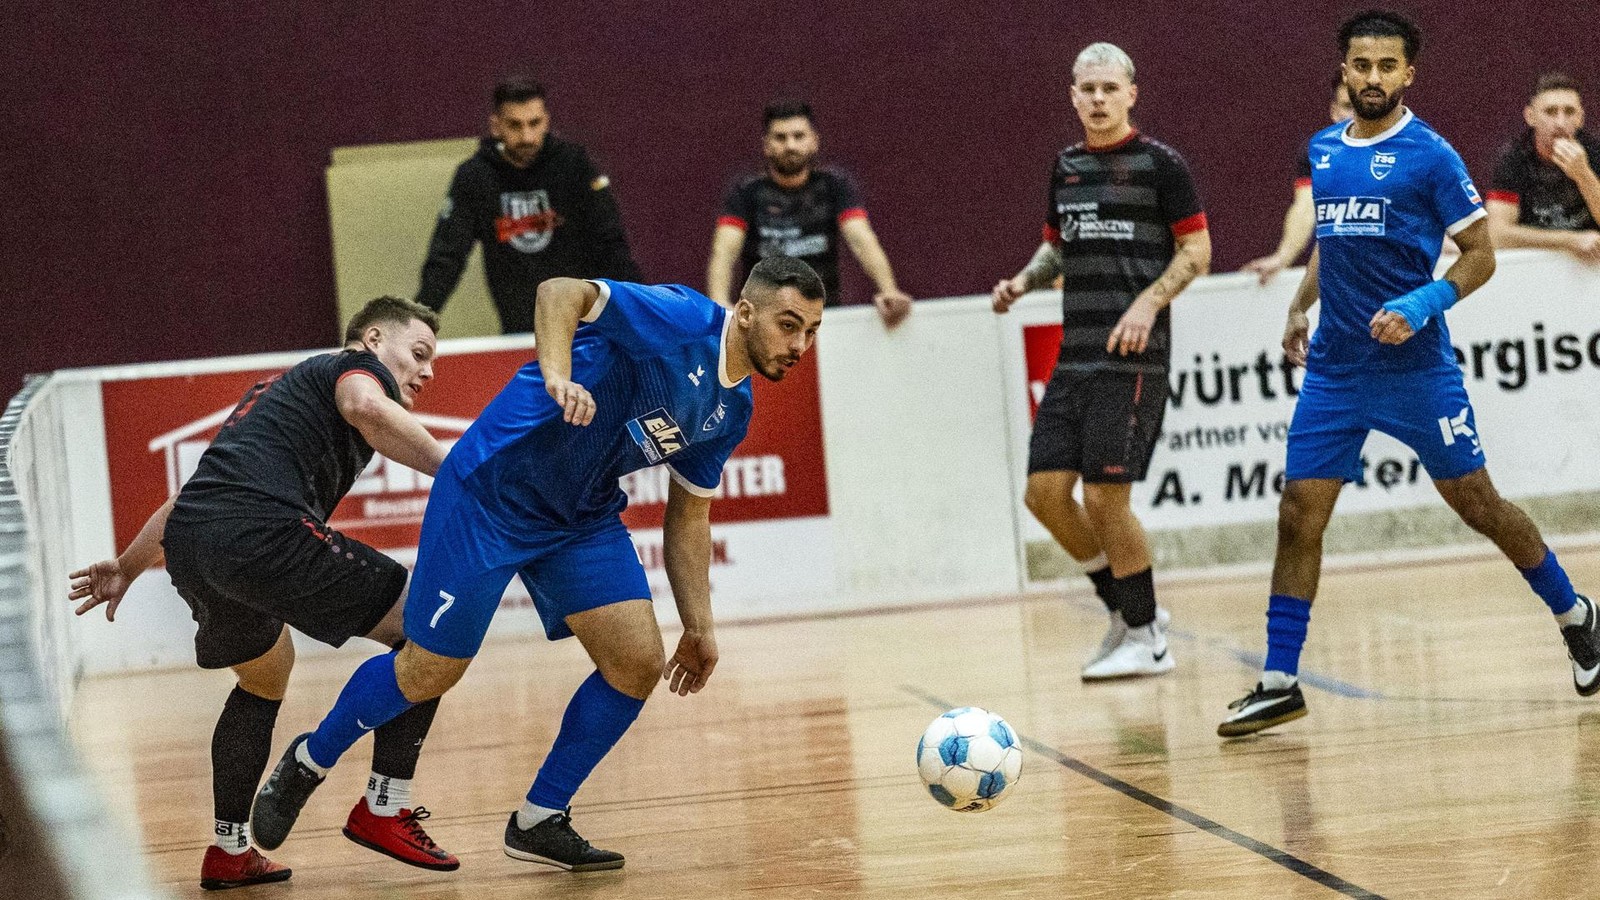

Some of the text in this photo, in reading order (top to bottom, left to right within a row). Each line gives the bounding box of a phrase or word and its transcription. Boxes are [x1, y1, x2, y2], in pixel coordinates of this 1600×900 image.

[1158, 420, 1289, 451] artner vo
[1152, 470, 1200, 507] A.
[429, 589, 456, 629] 7
